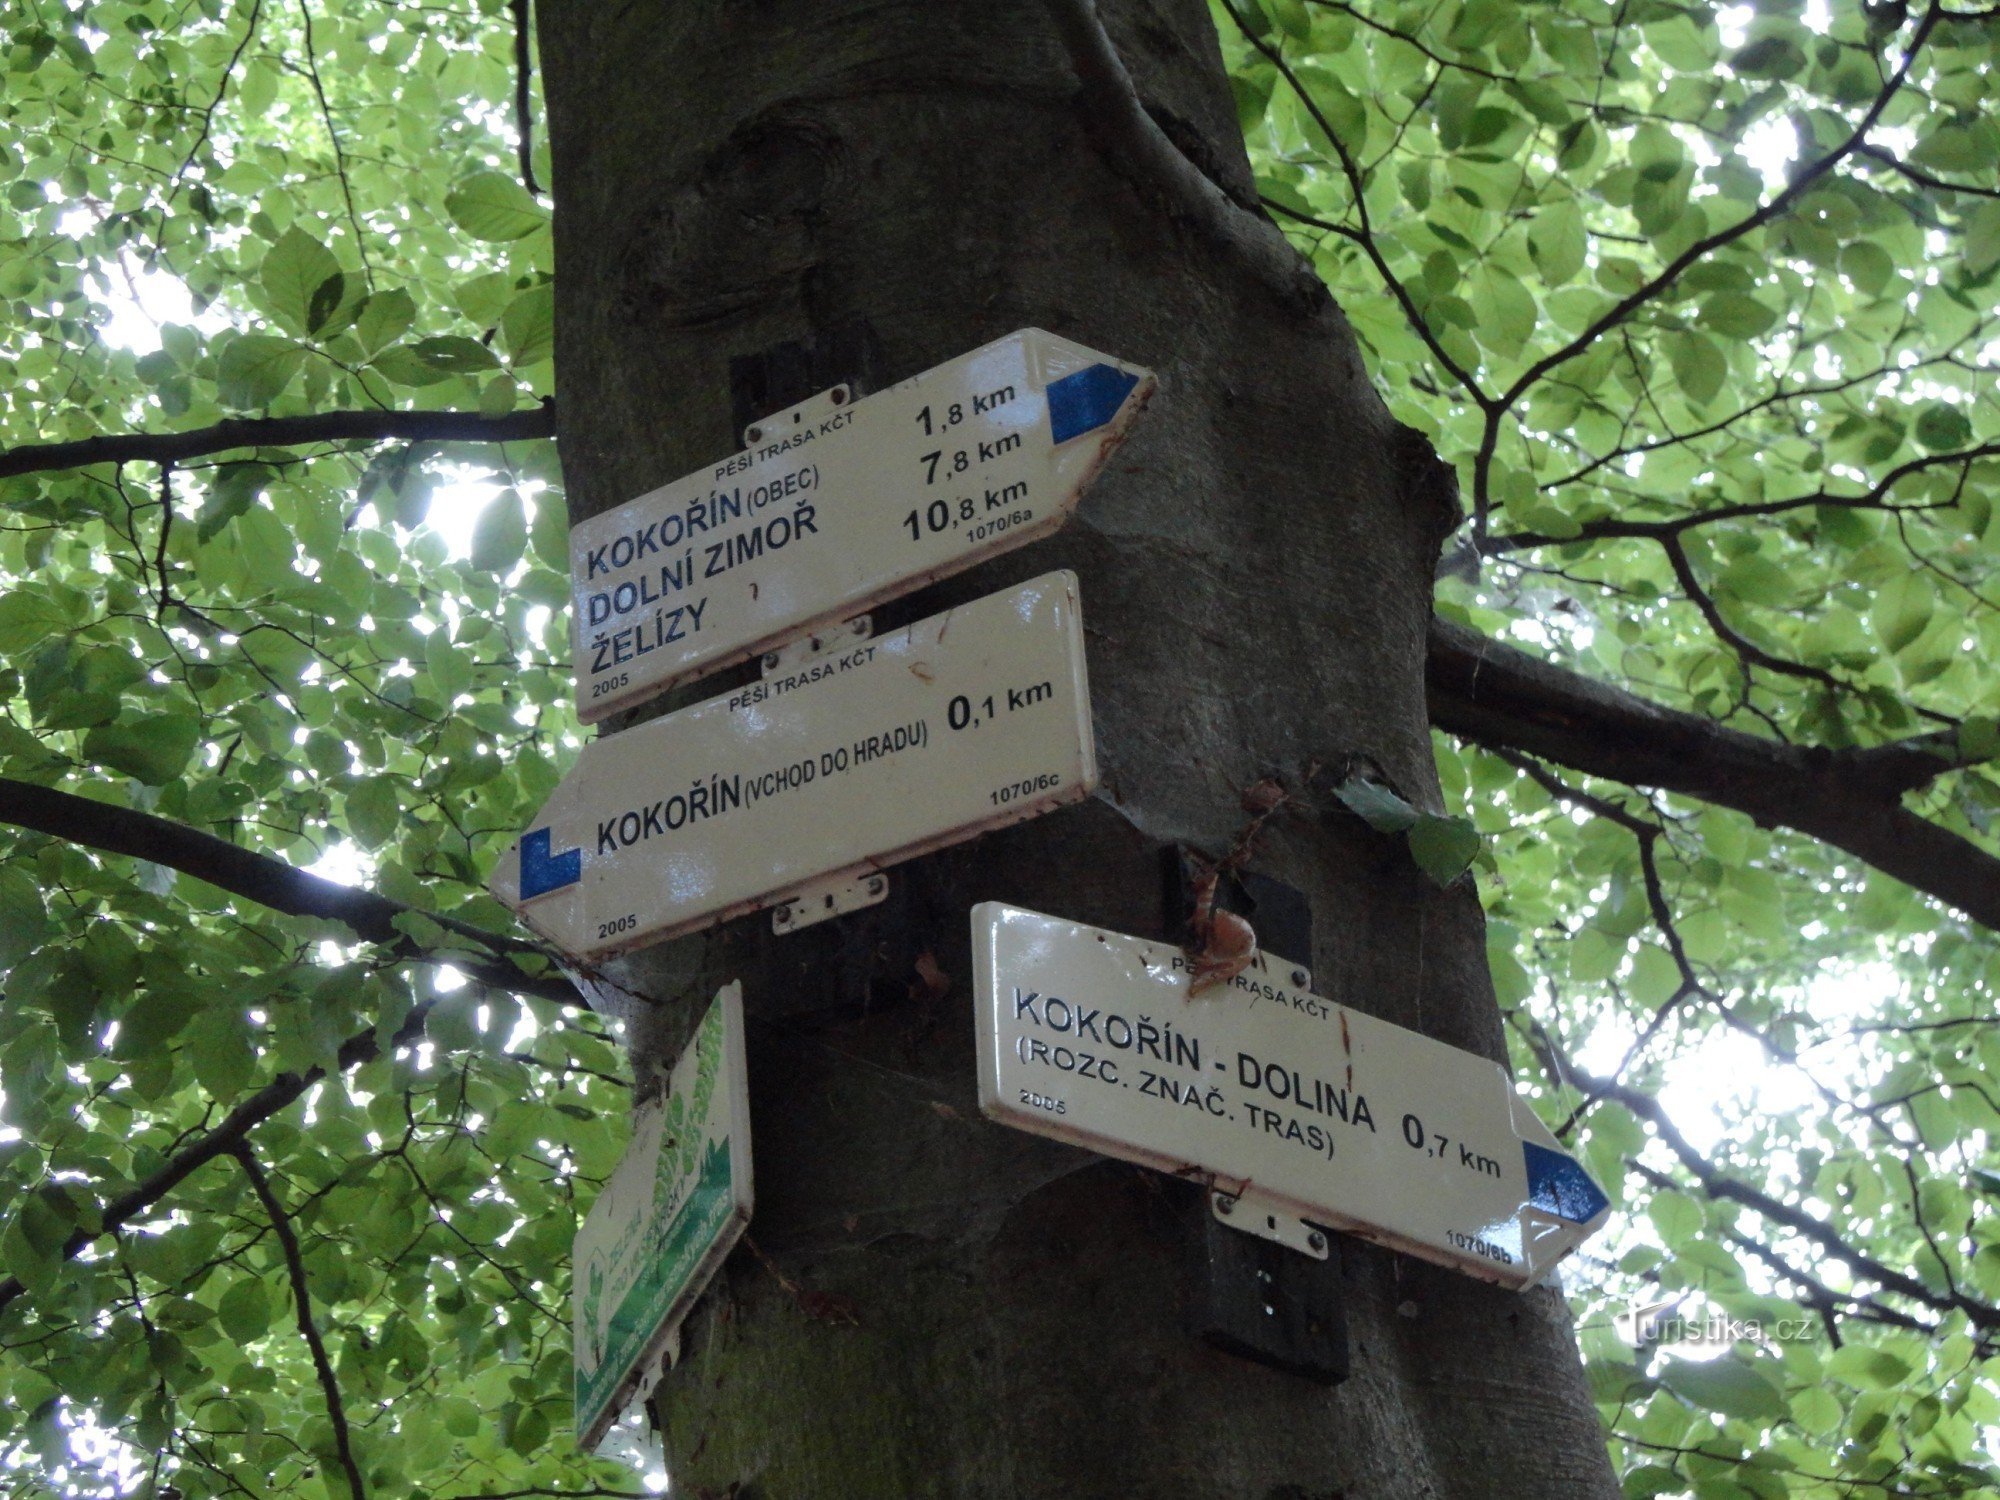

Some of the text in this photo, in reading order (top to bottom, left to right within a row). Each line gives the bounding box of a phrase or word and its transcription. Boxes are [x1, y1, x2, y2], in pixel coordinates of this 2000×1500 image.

[715, 411, 855, 481] PĚŠÍ TRASA KČT
[588, 385, 1015, 580] KOKOŘÍN (OBEC) 1,8 km
[589, 433, 1021, 627] DOLNÍ ZIMOŘ 7,8 km
[966, 509, 1033, 543] 1070/6a
[590, 481, 1028, 675] ŽELÍZY 10,8 km
[592, 672, 629, 698] 2005
[729, 646, 877, 712] PĚŠÍ TRASA KČT
[597, 681, 1053, 855] KOKOŘÍN (VCHOD DO HRADU) 0,1 km
[989, 773, 1060, 806] 1070/6c
[598, 915, 637, 939] 2005
[1293, 996, 1329, 1021] KČT
[1013, 987, 1200, 1072] KOKOŘÍN
[1237, 1052, 1376, 1134] DOLINA
[1402, 1114, 1448, 1158] 0,7
[1459, 1142, 1501, 1179] km
[1016, 1035, 1334, 1161] (ROZC. ZNAČ. TRAS)
[1019, 1088, 1066, 1115] 2005
[1446, 1229, 1513, 1265] 1070/6b
